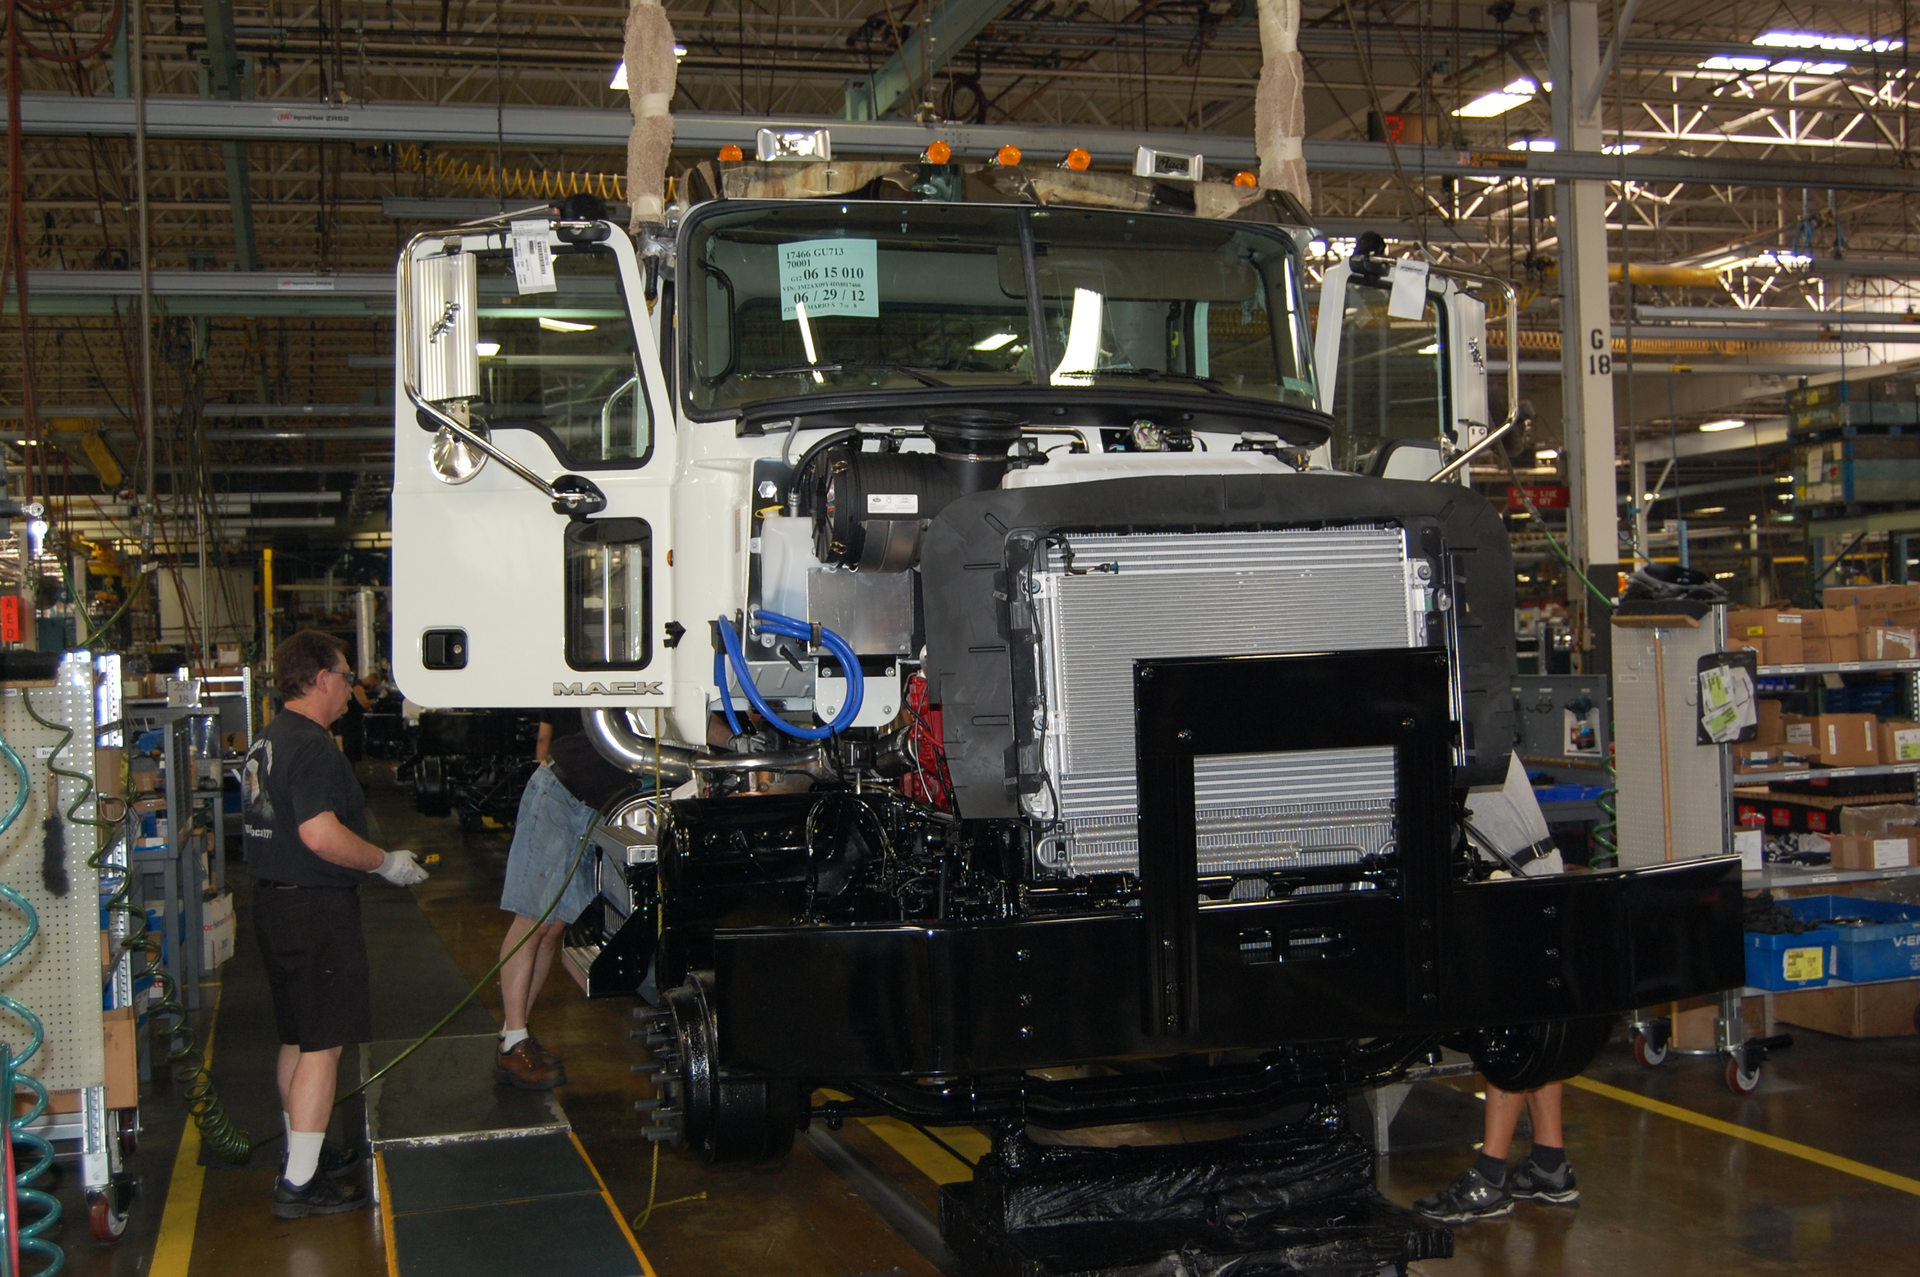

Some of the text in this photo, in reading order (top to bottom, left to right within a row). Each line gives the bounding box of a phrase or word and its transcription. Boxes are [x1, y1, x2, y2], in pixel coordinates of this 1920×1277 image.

[786, 247, 844, 260] 17466 GU713
[786, 259, 811, 269] 70001
[803, 268, 819, 281] 06
[824, 266, 838, 278] 15
[842, 267, 864, 279] 010
[793, 291, 809, 304] 06
[822, 288, 838, 301] 29
[851, 290, 865, 302] 12
[807, 302, 830, 310] MARIO
[1591, 328, 1604, 350] G
[1589, 354, 1611, 375] 18
[174, 683, 193, 691] 220
[553, 681, 664, 696] MACK
[179, 695, 189, 703] 18
